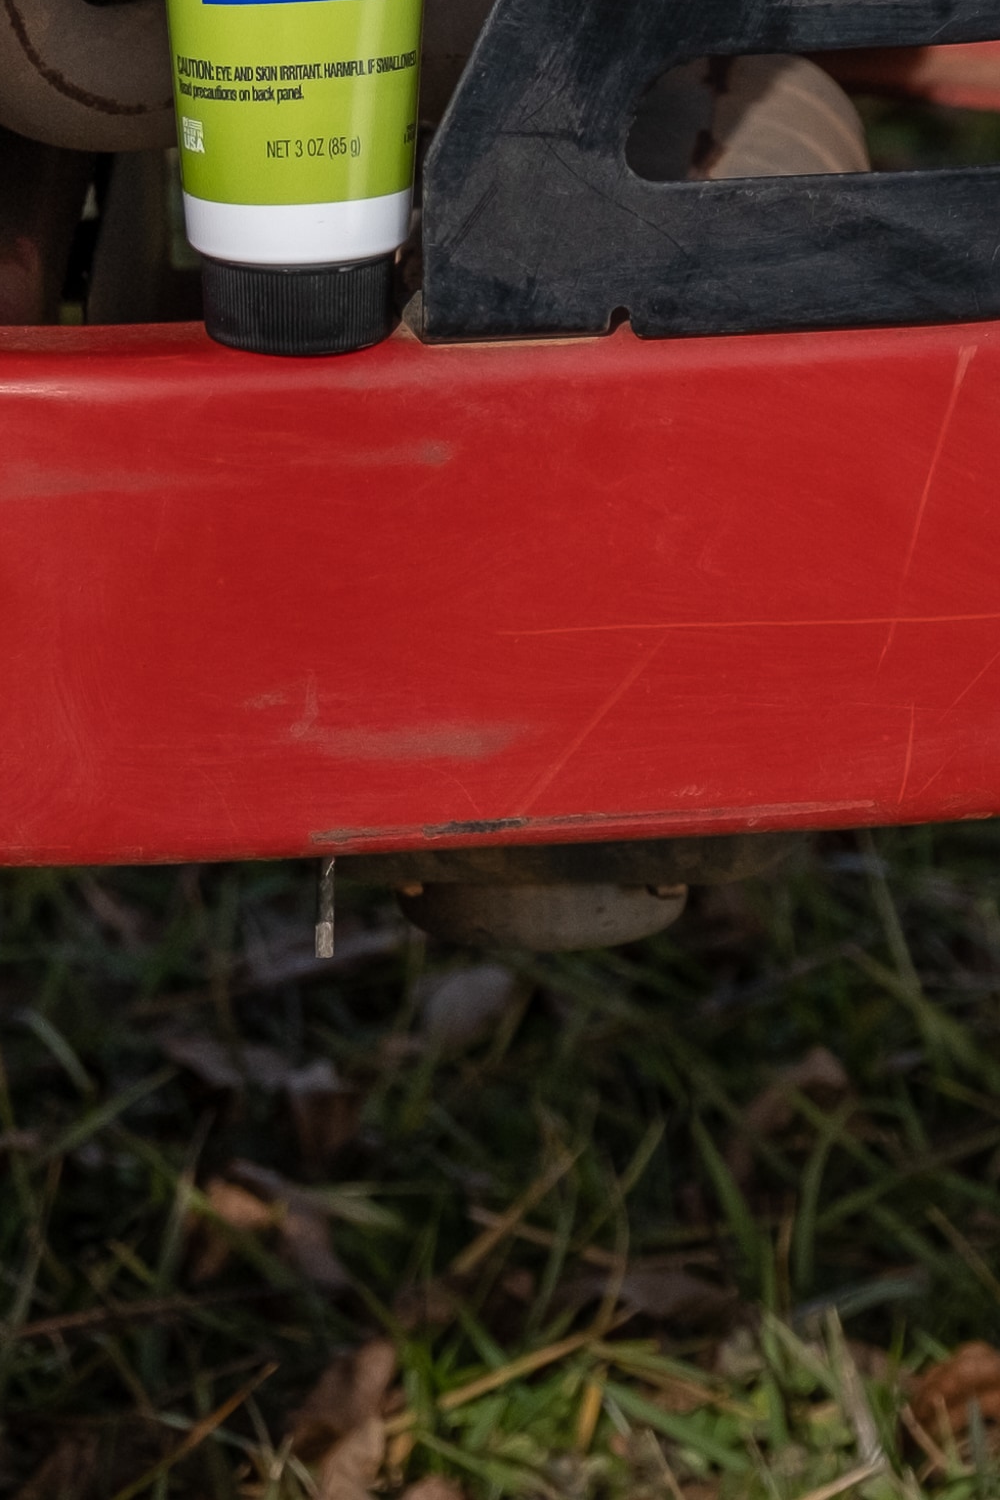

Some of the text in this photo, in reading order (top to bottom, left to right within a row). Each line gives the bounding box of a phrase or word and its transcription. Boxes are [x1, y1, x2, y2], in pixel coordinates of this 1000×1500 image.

[177, 55, 214, 80] CAUTION:
[216, 66, 232, 81] EYE
[234, 66, 253, 82] AND
[256, 66, 277, 82] SKIN
[324, 61, 365, 77] HARMFUL
[367, 58, 375, 74] IF
[193, 84, 237, 101] precautions
[239, 88, 250, 101] on
[252, 85, 275, 101] back
[277, 83, 304, 104] panel.
[184, 133, 205, 153] USA
[267, 137, 361, 160] NET 3 OZ (85 g)
